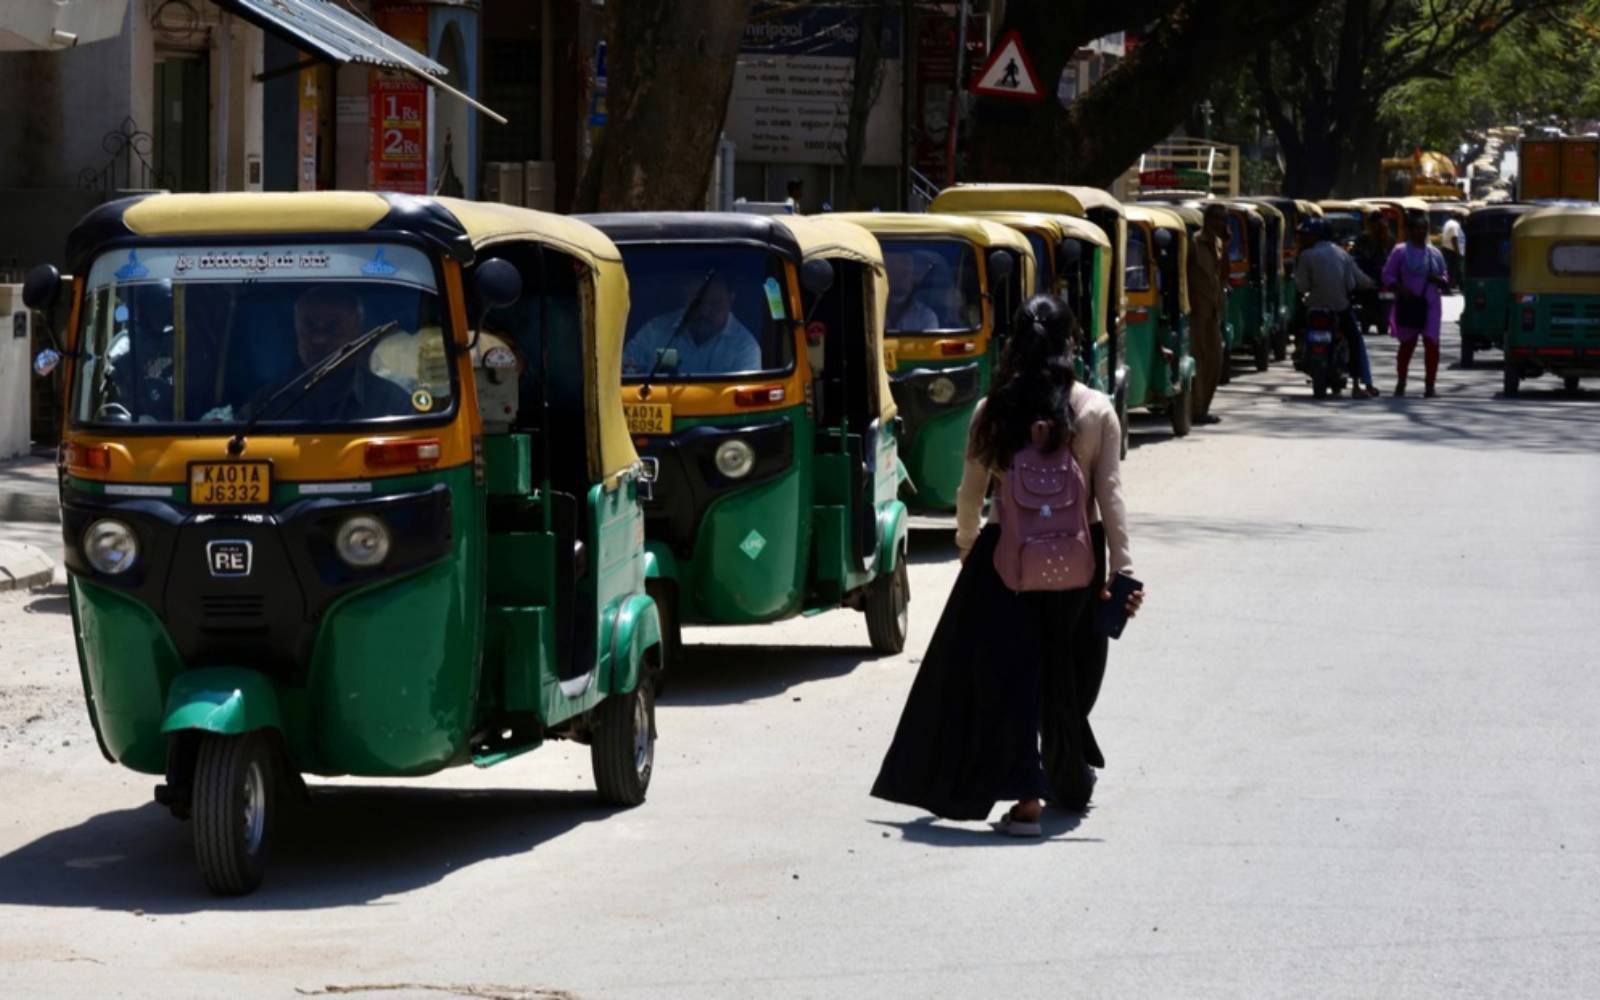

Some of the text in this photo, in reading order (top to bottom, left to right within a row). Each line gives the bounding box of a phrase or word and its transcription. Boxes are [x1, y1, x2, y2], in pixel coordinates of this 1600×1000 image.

[745, 20, 804, 41] hirlpool
[385, 95, 401, 121] 1
[402, 106, 418, 121] Rs
[384, 130, 403, 154] 2
[204, 465, 260, 483] KA01A
[204, 484, 260, 502] J6332
[214, 552, 245, 570] RE
